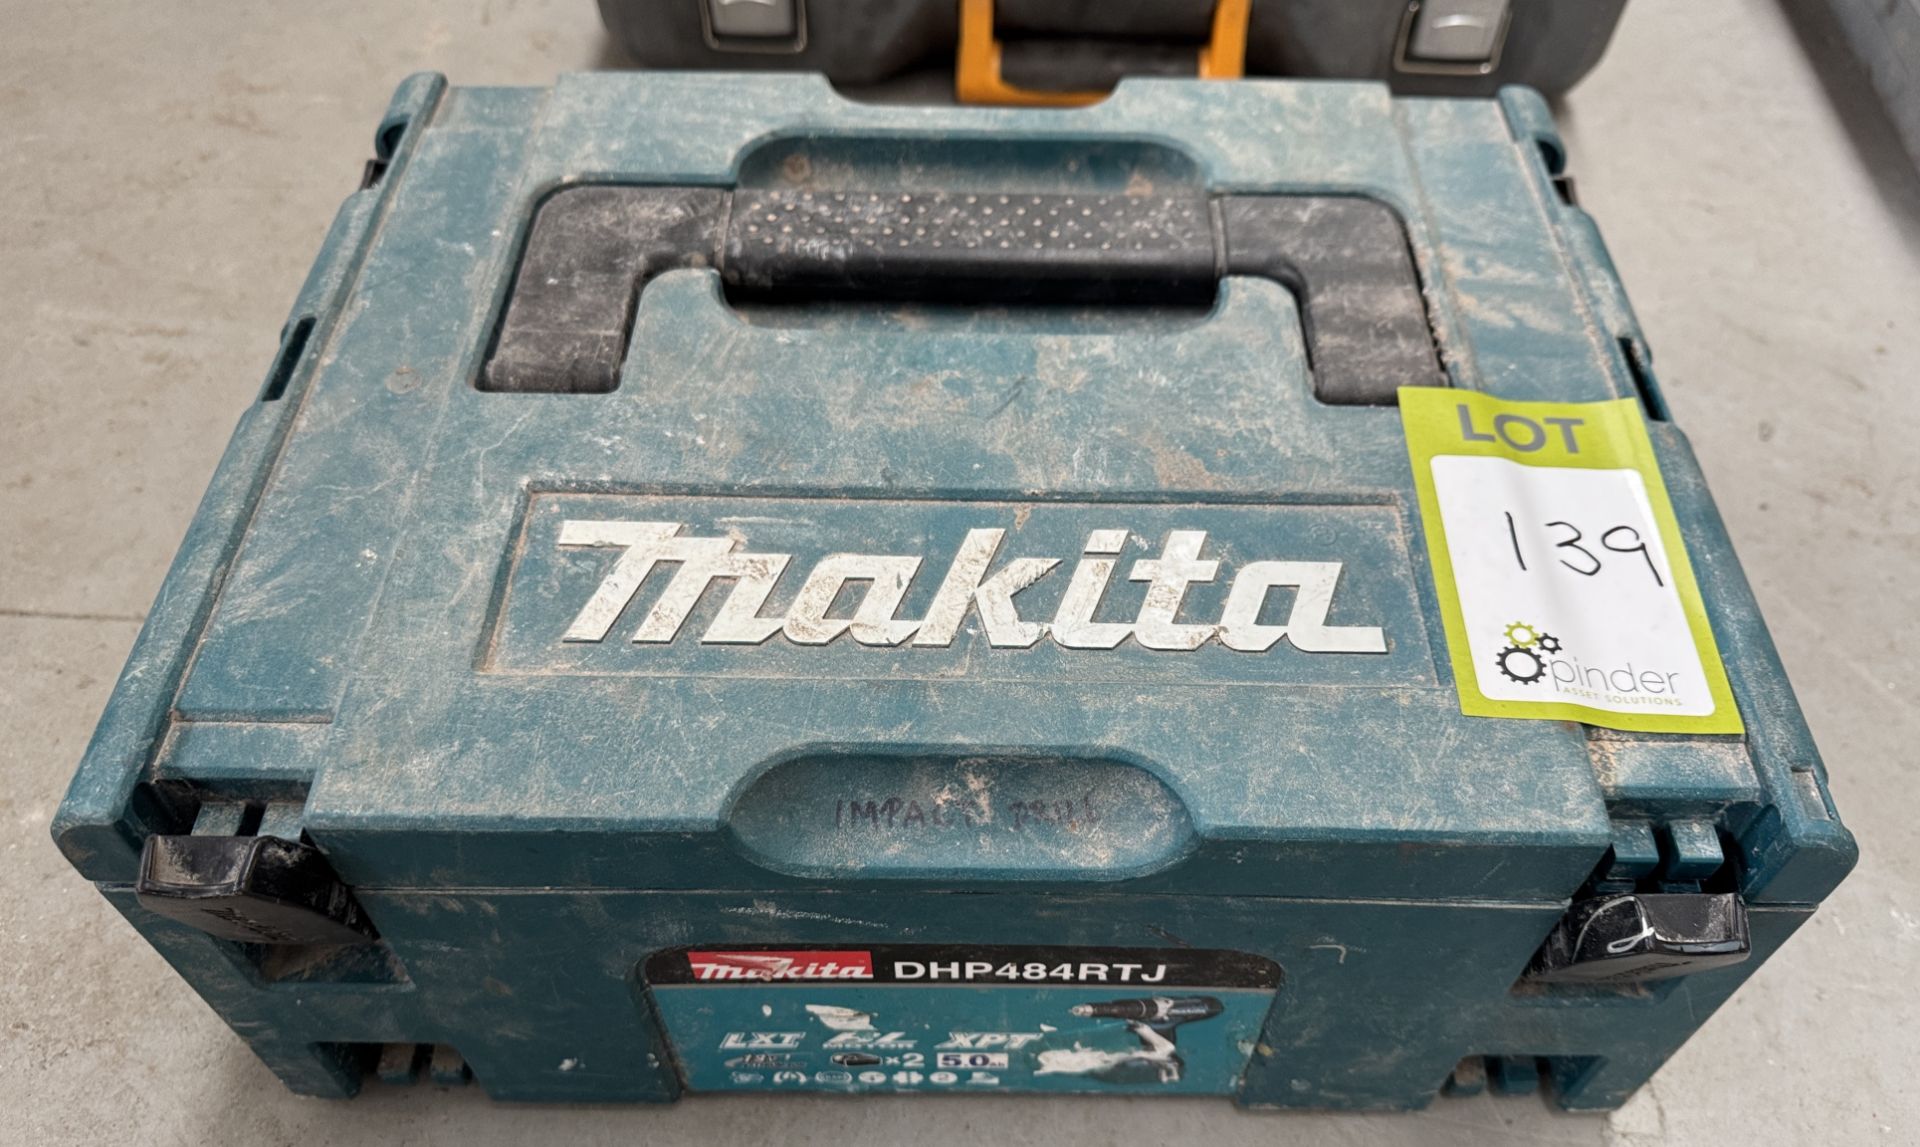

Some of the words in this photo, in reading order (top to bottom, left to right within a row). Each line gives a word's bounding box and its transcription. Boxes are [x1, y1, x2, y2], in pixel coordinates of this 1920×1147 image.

[1456, 403, 1585, 454] LOT
[1504, 510, 1664, 588] 139
[1549, 656, 1680, 695] pinder
[1563, 687, 1599, 700] ASSET
[1604, 694, 1683, 707] SOLUTIONS
[893, 961, 1167, 983] DHP484RTJ
[719, 1031, 806, 1050] LXT
[933, 1031, 1044, 1050] XPT
